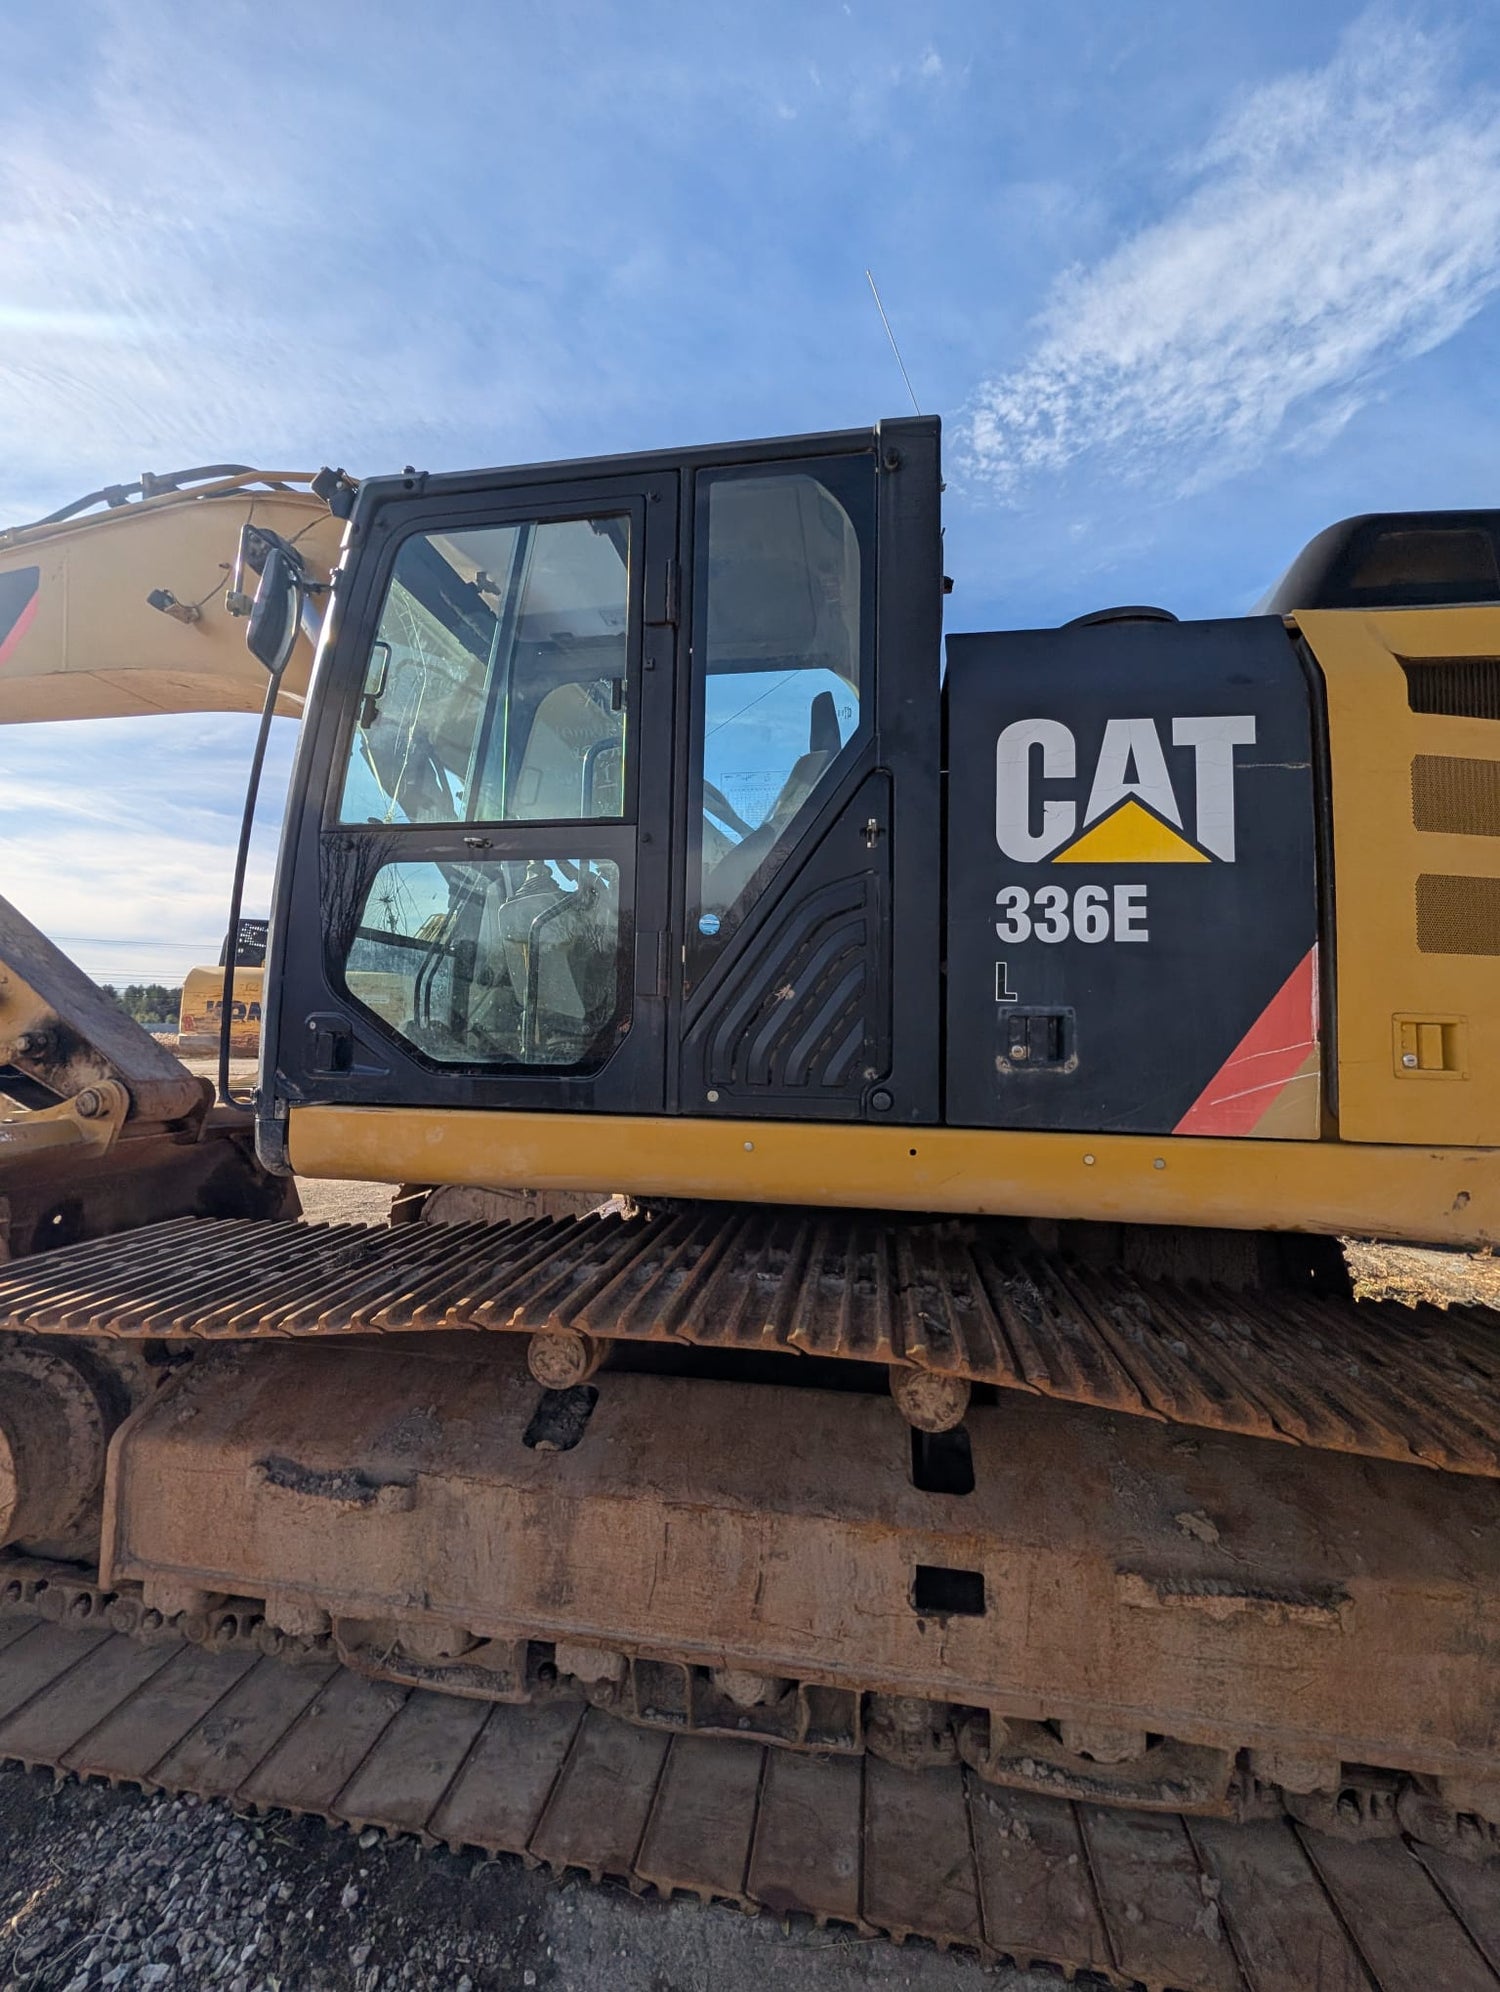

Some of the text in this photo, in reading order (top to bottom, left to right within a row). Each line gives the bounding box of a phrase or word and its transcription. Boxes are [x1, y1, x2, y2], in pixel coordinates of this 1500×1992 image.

[996, 715, 1257, 863] CAT
[995, 885, 1149, 944] 336E
[995, 961, 1018, 1003] L
